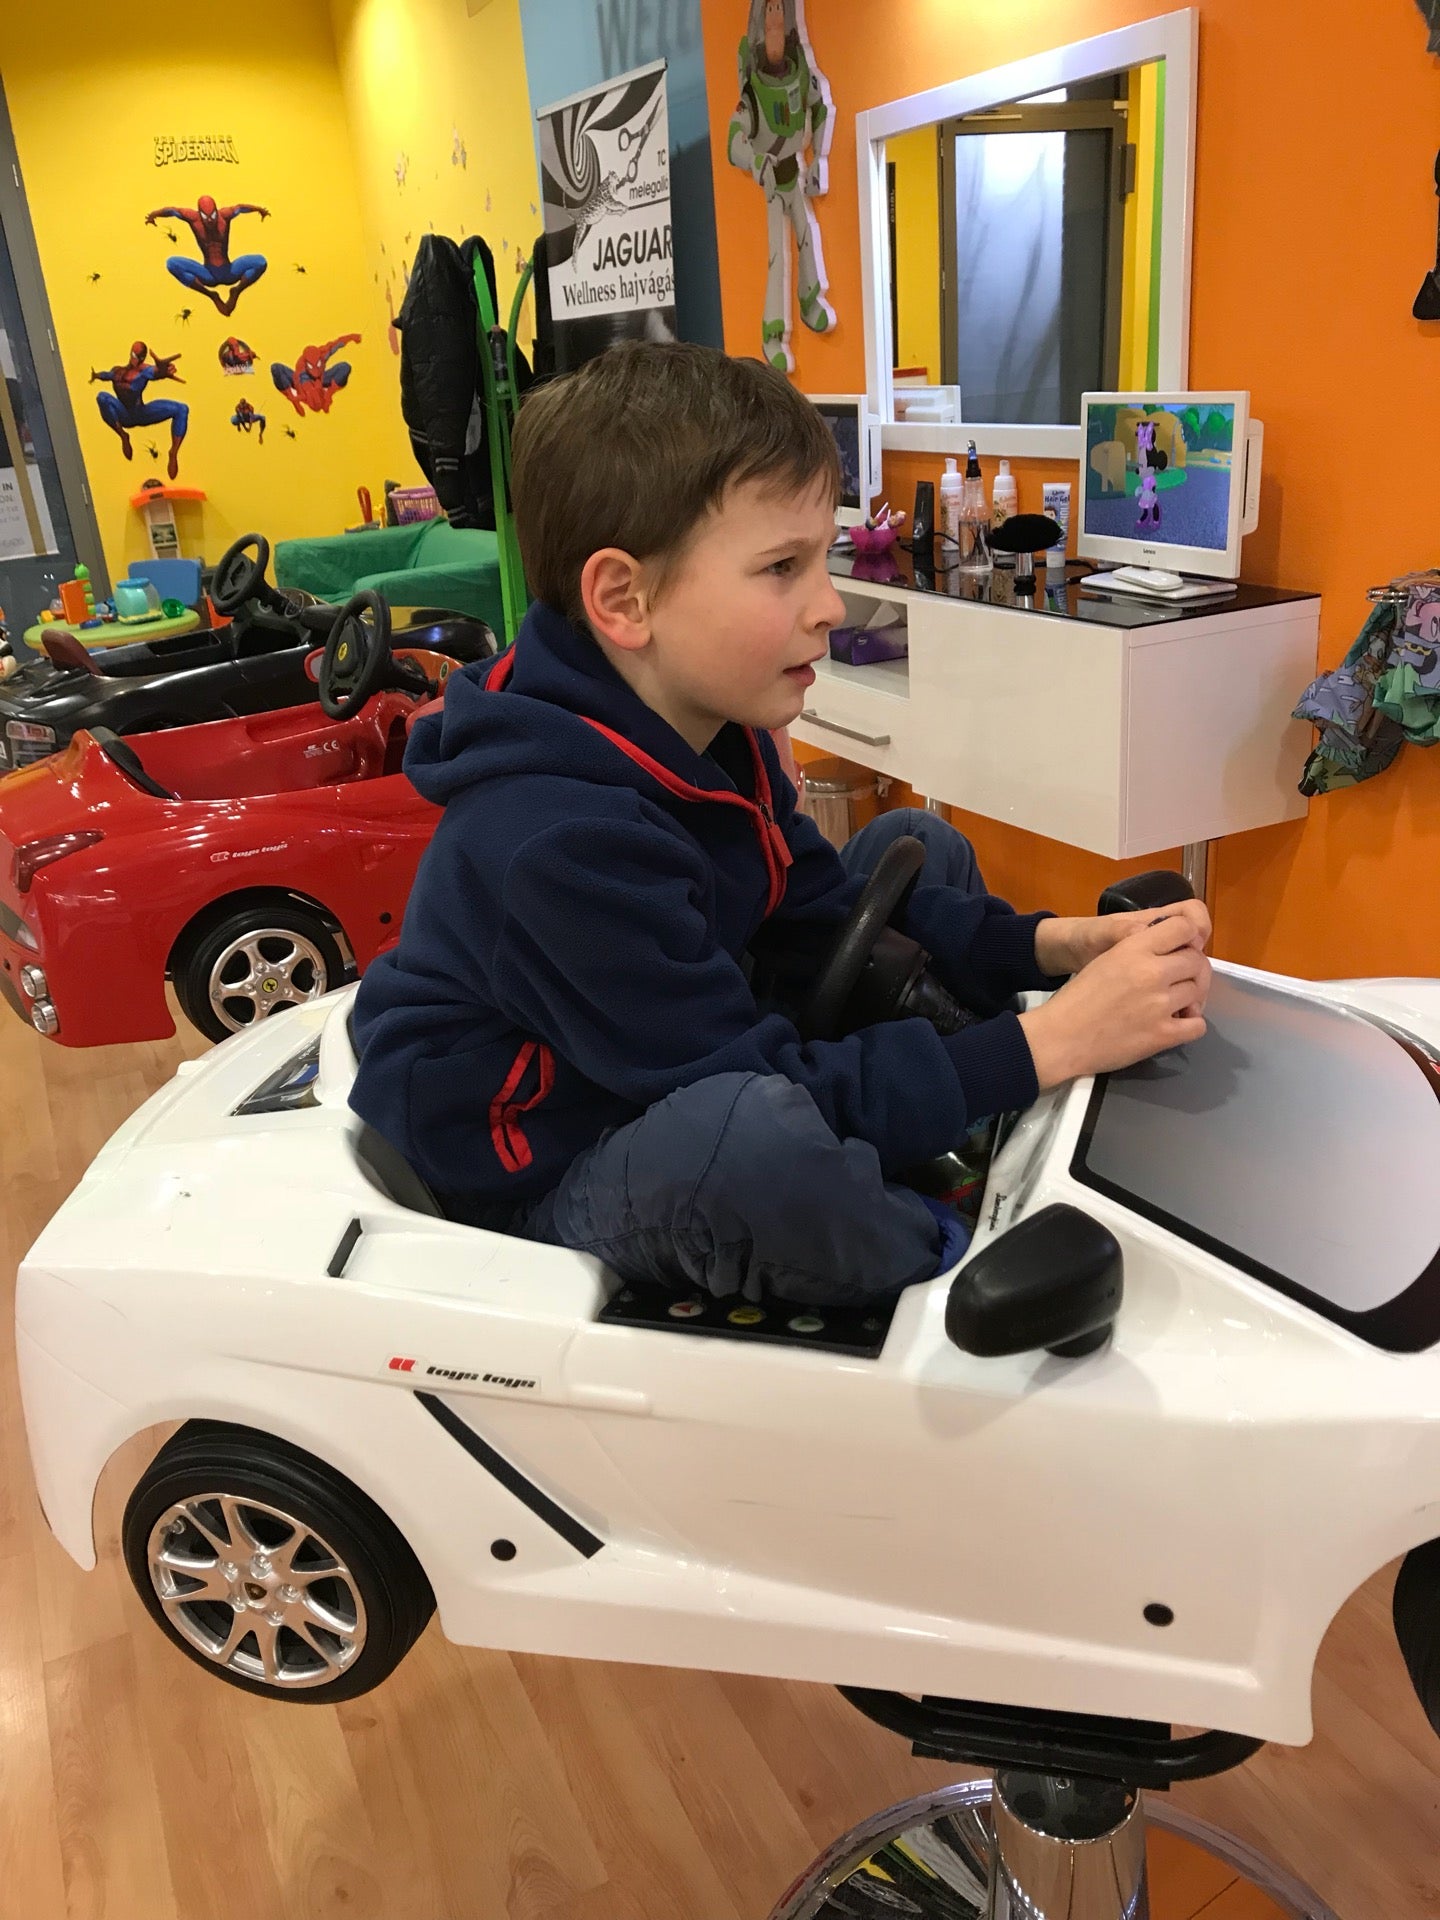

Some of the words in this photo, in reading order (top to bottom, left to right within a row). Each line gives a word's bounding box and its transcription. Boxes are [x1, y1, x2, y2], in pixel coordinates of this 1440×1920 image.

[592, 224, 673, 271] JAGUAR
[562, 280, 617, 307] Wellness
[426, 1366, 479, 1380] toys
[482, 1373, 536, 1388] toys
